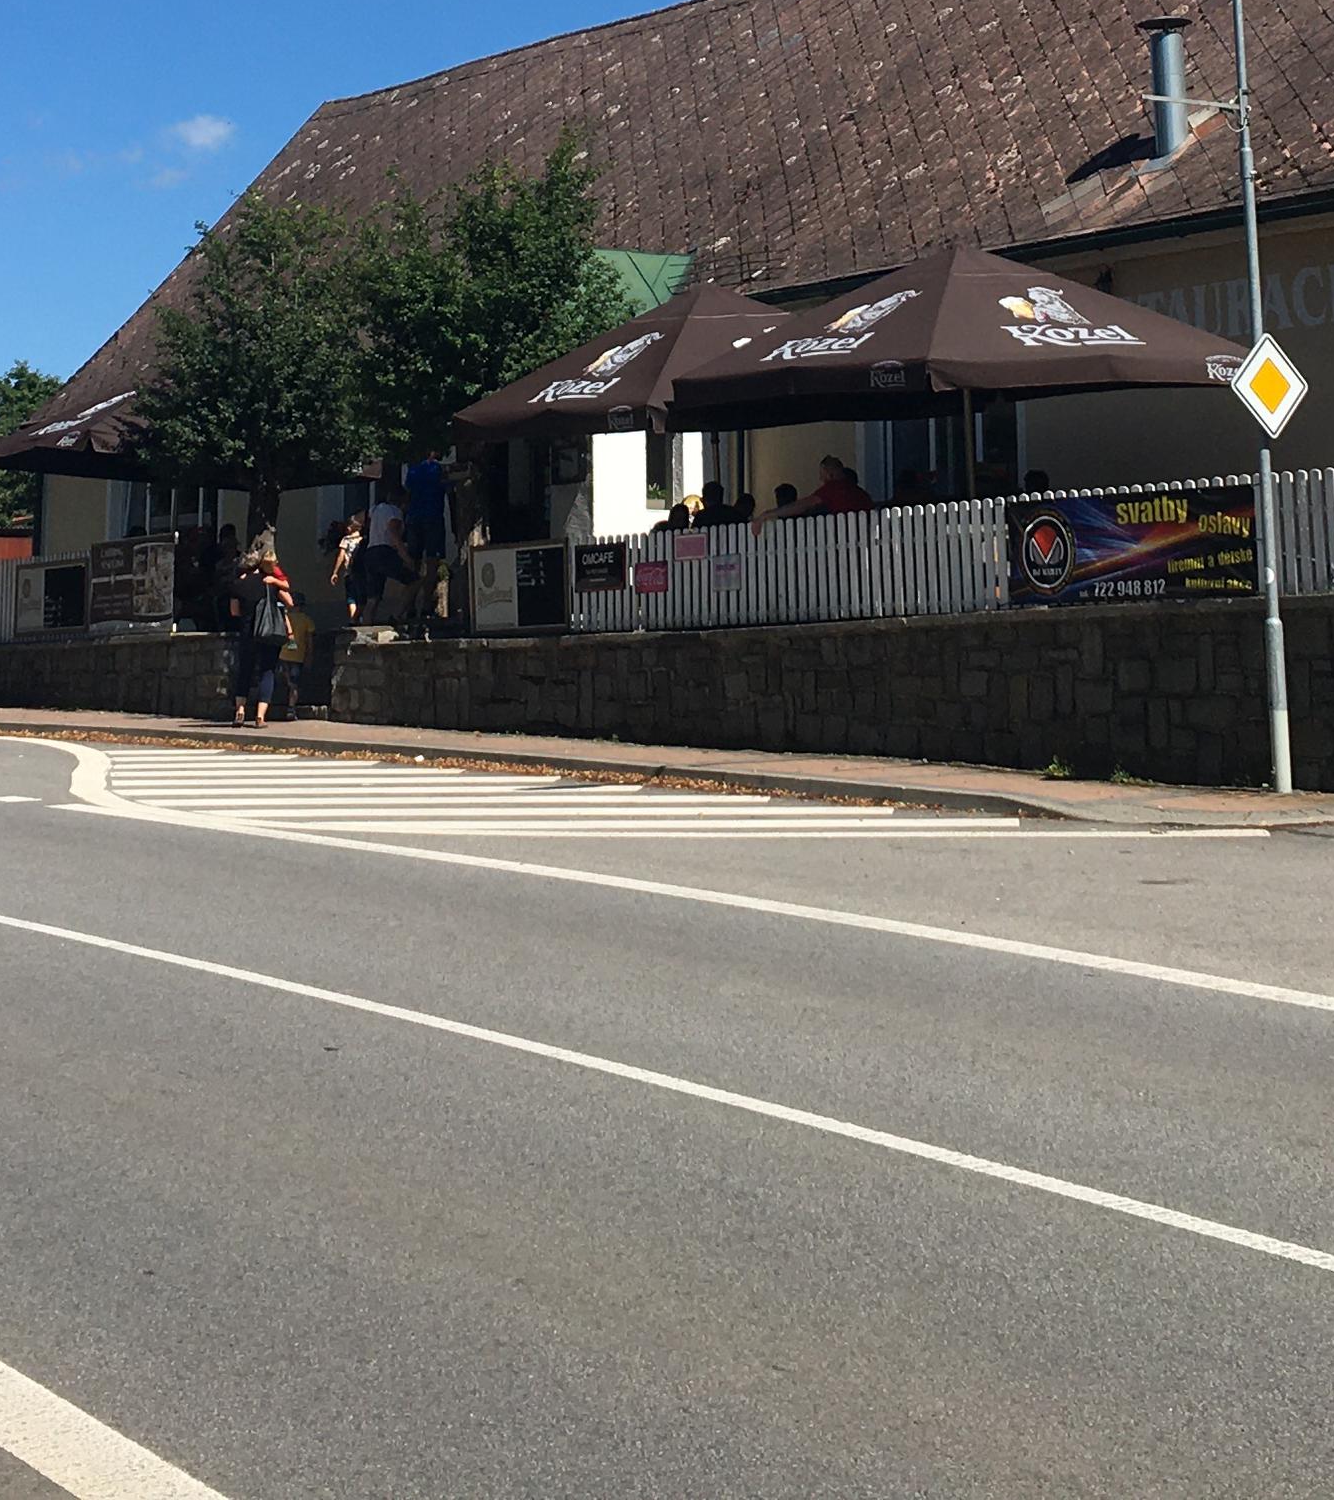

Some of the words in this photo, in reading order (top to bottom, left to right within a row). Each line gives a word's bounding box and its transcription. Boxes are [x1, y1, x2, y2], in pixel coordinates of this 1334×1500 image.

[759, 331, 875, 361] Kozel
[1000, 323, 1147, 347] Kozel
[527, 377, 621, 403] Kozel
[870, 370, 907, 389] Kozel
[1115, 495, 1189, 525] svatby
[1197, 510, 1252, 539] oslavy
[1207, 555, 1216, 569] a
[1093, 580, 1115, 597] 722
[1117, 580, 1142, 597] 948
[1144, 578, 1166, 595] 812
